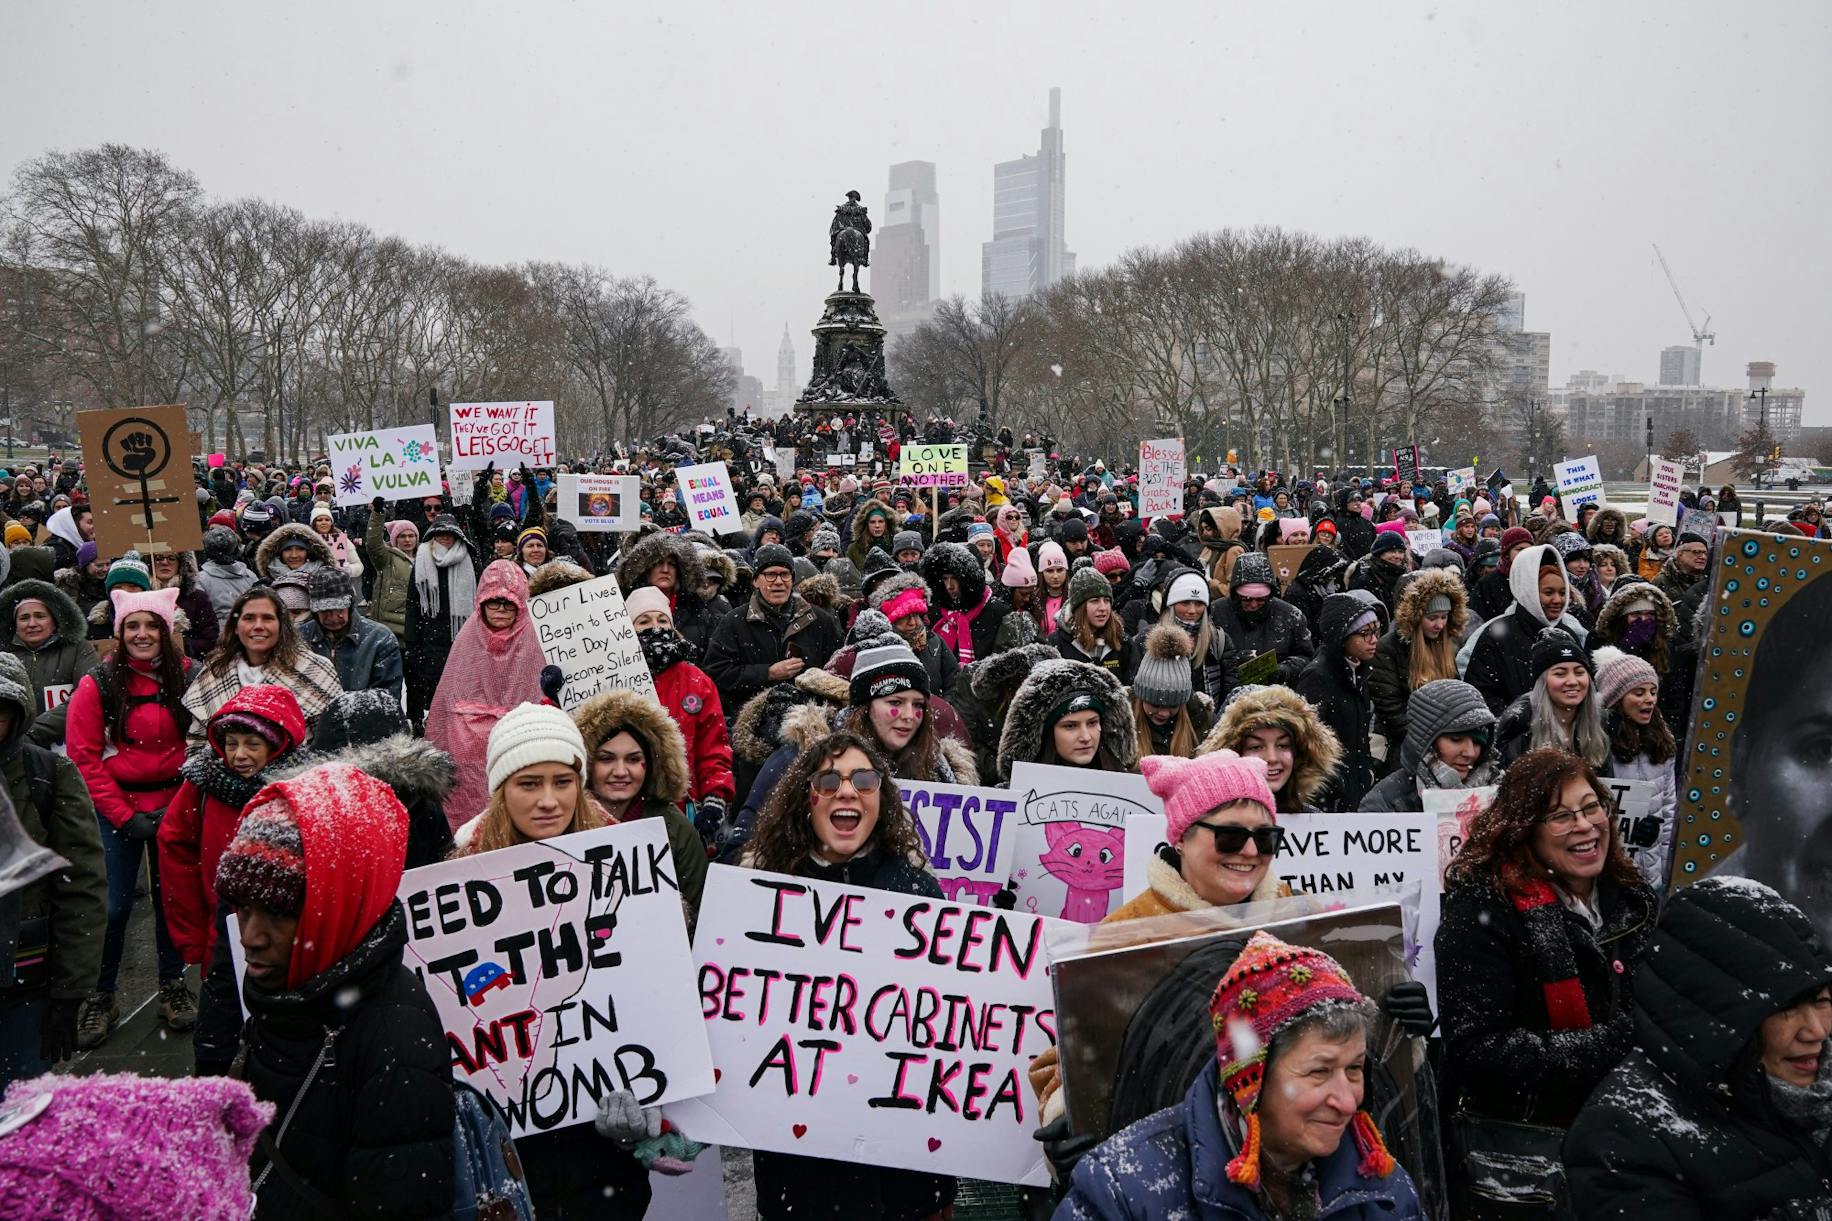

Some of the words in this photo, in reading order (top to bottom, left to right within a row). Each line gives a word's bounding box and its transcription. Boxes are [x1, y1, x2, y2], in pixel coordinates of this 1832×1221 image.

[455, 407, 481, 418] WE
[486, 407, 520, 419] WANT
[491, 421, 519, 435] GOT
[334, 435, 379, 452] VIVA
[455, 436, 495, 456] LETS
[497, 435, 519, 452] GO
[520, 436, 550, 455] GET
[370, 452, 395, 468] LA
[533, 453, 554, 466] IT
[908, 447, 961, 461] LOVE
[1142, 444, 1184, 461] Blessed
[912, 461, 954, 474] ONE
[1145, 461, 1160, 473] Be
[1160, 461, 1181, 476] THE
[1566, 465, 1586, 474] THIS
[1660, 464, 1674, 474] SOUL
[371, 470, 431, 490] VULVA
[688, 476, 721, 490] EQUAL
[901, 474, 966, 487] ANOTHER
[1573, 473, 1595, 483] WHAT
[1656, 473, 1678, 484] SISTERS
[1652, 481, 1679, 493] MARCHING
[692, 489, 725, 504] MEANS
[1571, 494, 1597, 505] LOOKS
[1653, 497, 1674, 507] CHANGE
[697, 505, 730, 520] EQUAL
[532, 595, 570, 619] Our
[579, 586, 617, 604] Lives
[540, 622, 585, 643] Begin
[588, 614, 600, 627] to
[603, 603, 628, 622] End
[545, 646, 577, 664] The
[581, 637, 609, 654] Day
[610, 625, 634, 641] We
[561, 664, 604, 684] ecome
[607, 646, 643, 671] Silent
[563, 680, 603, 706] About
[870, 677, 912, 696] CHAMPIONS
[1036, 800, 1080, 821] CATS
[1089, 804, 1132, 822] AGAI
[900, 789, 1018, 874] SIST
[1275, 830, 1330, 859] AVE
[1344, 828, 1421, 856] MORE
[1280, 871, 1354, 894] THAN
[407, 880, 503, 941] EED
[513, 861, 579, 909] TO
[584, 843, 679, 900] TALK
[744, 877, 866, 955] I'VE
[894, 902, 1045, 981] SEEN
[494, 912, 622, 986] THE
[698, 962, 859, 1036] BETTER
[864, 983, 1058, 1056] CABINETS
[445, 1009, 537, 1076] ANT
[543, 994, 619, 1049] IN
[749, 1032, 843, 1097] AT
[866, 1051, 1026, 1125] IKEA
[485, 1043, 668, 1133] WOMB
